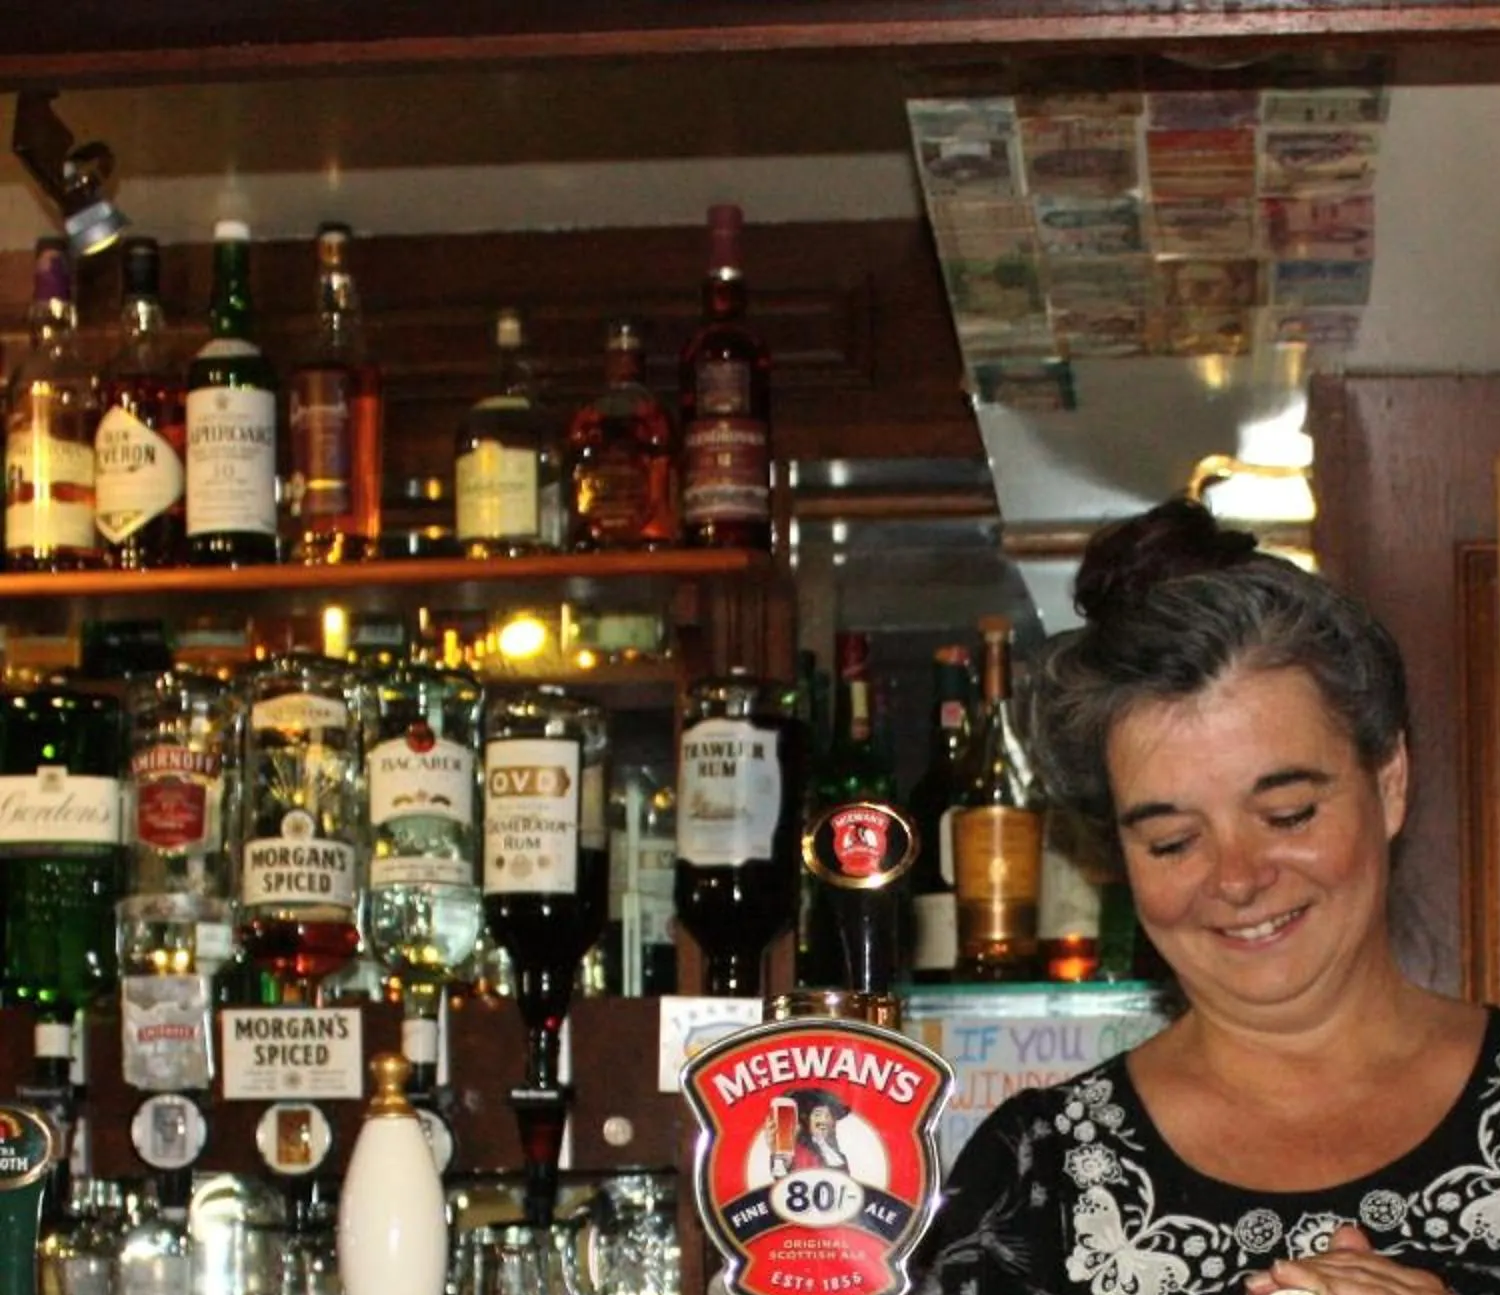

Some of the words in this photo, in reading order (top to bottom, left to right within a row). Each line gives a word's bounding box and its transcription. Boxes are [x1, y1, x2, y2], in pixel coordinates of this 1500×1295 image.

[685, 742, 765, 760] TRAWLR
[492, 771, 559, 793] OVD
[503, 836, 541, 850] RUM
[263, 871, 332, 894] SPICED
[235, 1012, 349, 1041] MORGAN'S
[254, 1043, 330, 1066] SPICED
[954, 1025, 998, 1062] IF
[1011, 1025, 1085, 1062] YOU
[712, 1045, 922, 1105] McEWAN'S
[731, 1201, 769, 1229] FINE
[785, 1179, 857, 1214] 80/-
[864, 1202, 899, 1225] ALE
[782, 1237, 850, 1250] ORIGINAL
[768, 1250, 836, 1262] SCOTTISH
[841, 1251, 868, 1262] ALE
